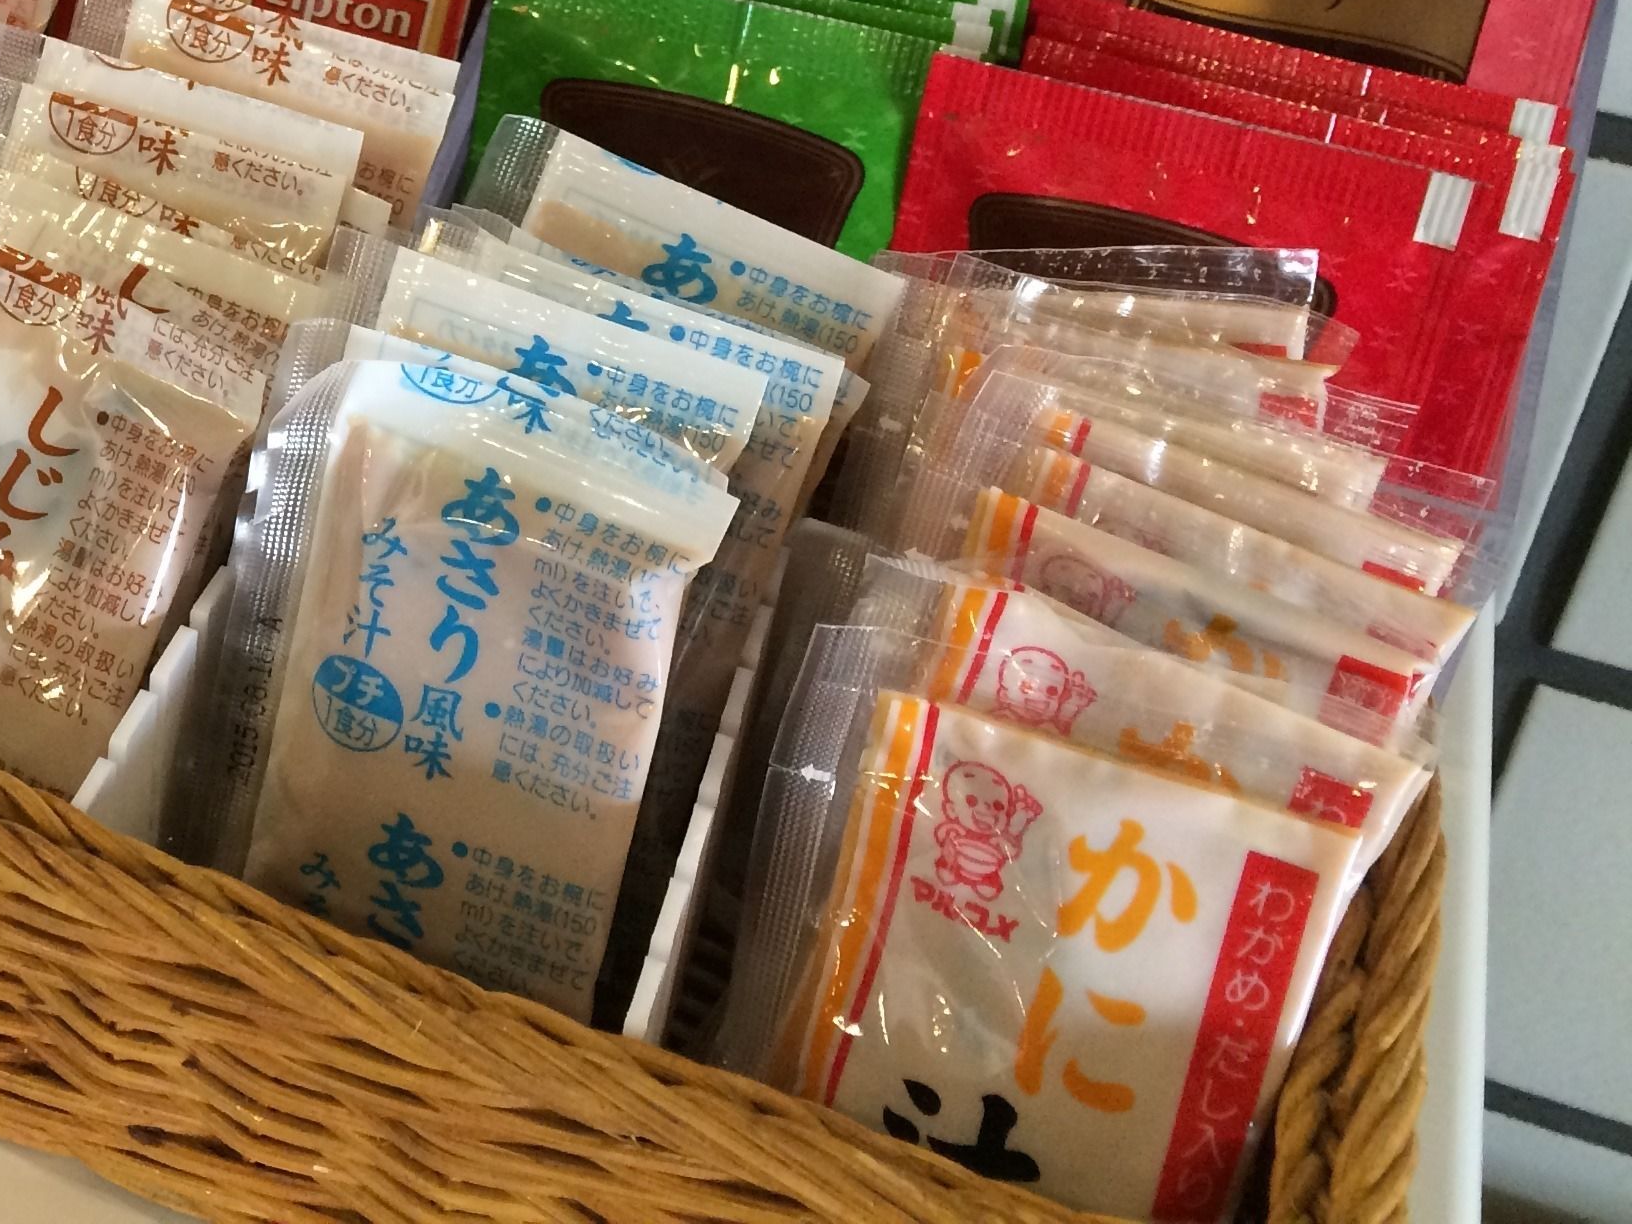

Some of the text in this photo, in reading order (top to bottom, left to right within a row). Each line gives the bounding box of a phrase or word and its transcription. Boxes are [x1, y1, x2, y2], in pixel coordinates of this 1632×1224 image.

[183, 16, 233, 59] 1食分
[68, 109, 116, 150] 1食分
[2, 275, 57, 321] 1食分
[641, 233, 718, 305] あ
[748, 266, 873, 331] 中身をお椀に
[688, 329, 825, 390] 中身をお椀に
[605, 364, 741, 429] 中身をお椀に
[109, 413, 216, 476] 中身をお椀に
[554, 502, 692, 576] 中身をお椀に
[343, 516, 409, 659] みそ汁
[530, 579, 663, 642] よくかきまぜて
[534, 556, 661, 615] ml)を注いで、
[16, 611, 136, 679] 熱湯の取扱い
[404, 466, 521, 780] あさり風味
[528, 603, 612, 657] ください。
[330, 658, 386, 704] プチ
[517, 650, 656, 721] により加減して
[522, 625, 659, 694] 湯量はお好み
[325, 694, 380, 748] 1食分
[512, 679, 598, 730] ください。
[499, 731, 634, 801] には、充分ご注
[503, 704, 641, 773] 熱湯の取扱い
[491, 758, 598, 822] 意ください。
[465, 874, 599, 937] あけ、熱湯(150
[472, 846, 607, 913] 中身をお椀に
[1014, 818, 1199, 1113] かに
